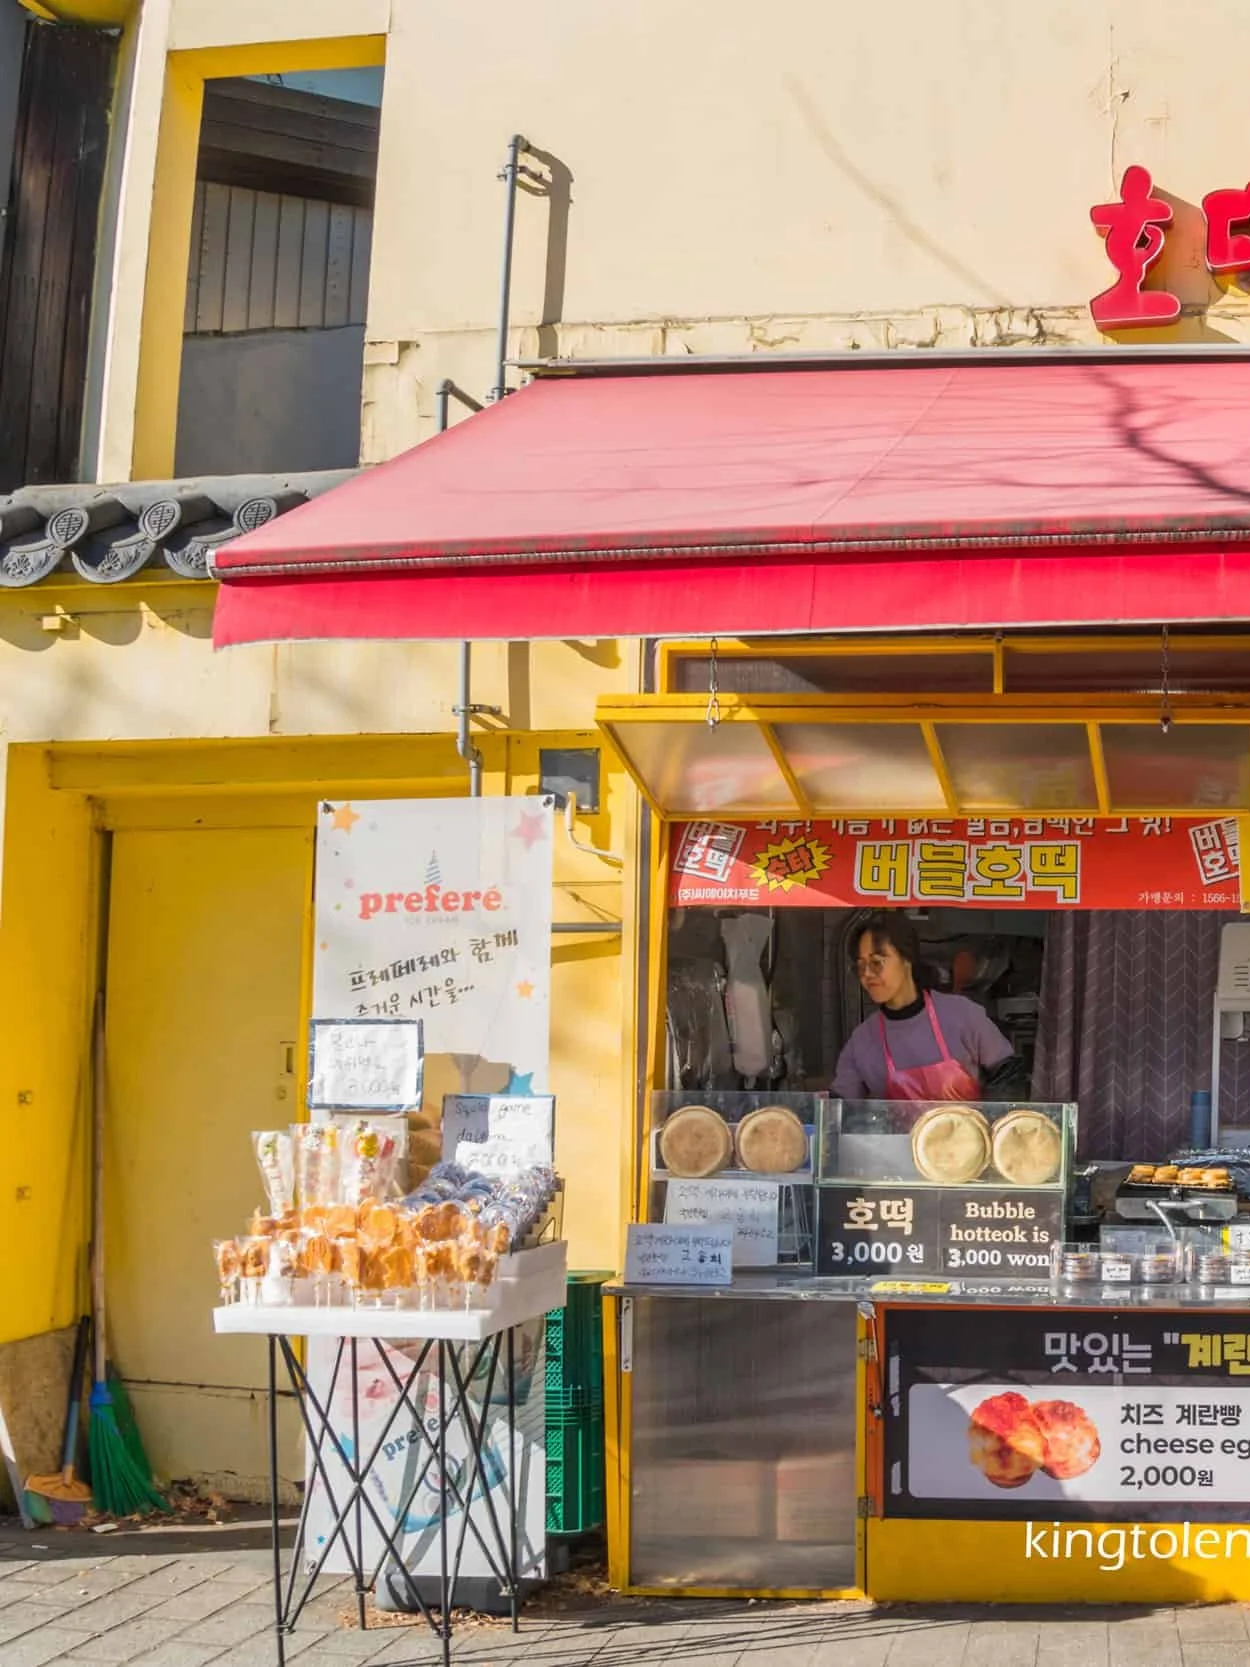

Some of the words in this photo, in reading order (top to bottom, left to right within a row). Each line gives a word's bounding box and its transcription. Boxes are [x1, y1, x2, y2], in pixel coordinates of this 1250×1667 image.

[858, 841, 1079, 902] 버블호떡
[470, 929, 519, 964] 함께
[843, 1197, 913, 1236] 호떡
[965, 1202, 1036, 1220] Bubble
[950, 1224, 1028, 1243] hotteok
[1032, 1226, 1049, 1243] is
[947, 1249, 1001, 1267] 3,000
[1007, 1253, 1050, 1267] won
[1045, 1331, 1152, 1374] 맛있는
[1120, 1403, 1163, 1426] 치즈
[1175, 1403, 1242, 1427] 계란빵
[1120, 1432, 1214, 1455] cheese
[1120, 1465, 1214, 1490] 2,000원
